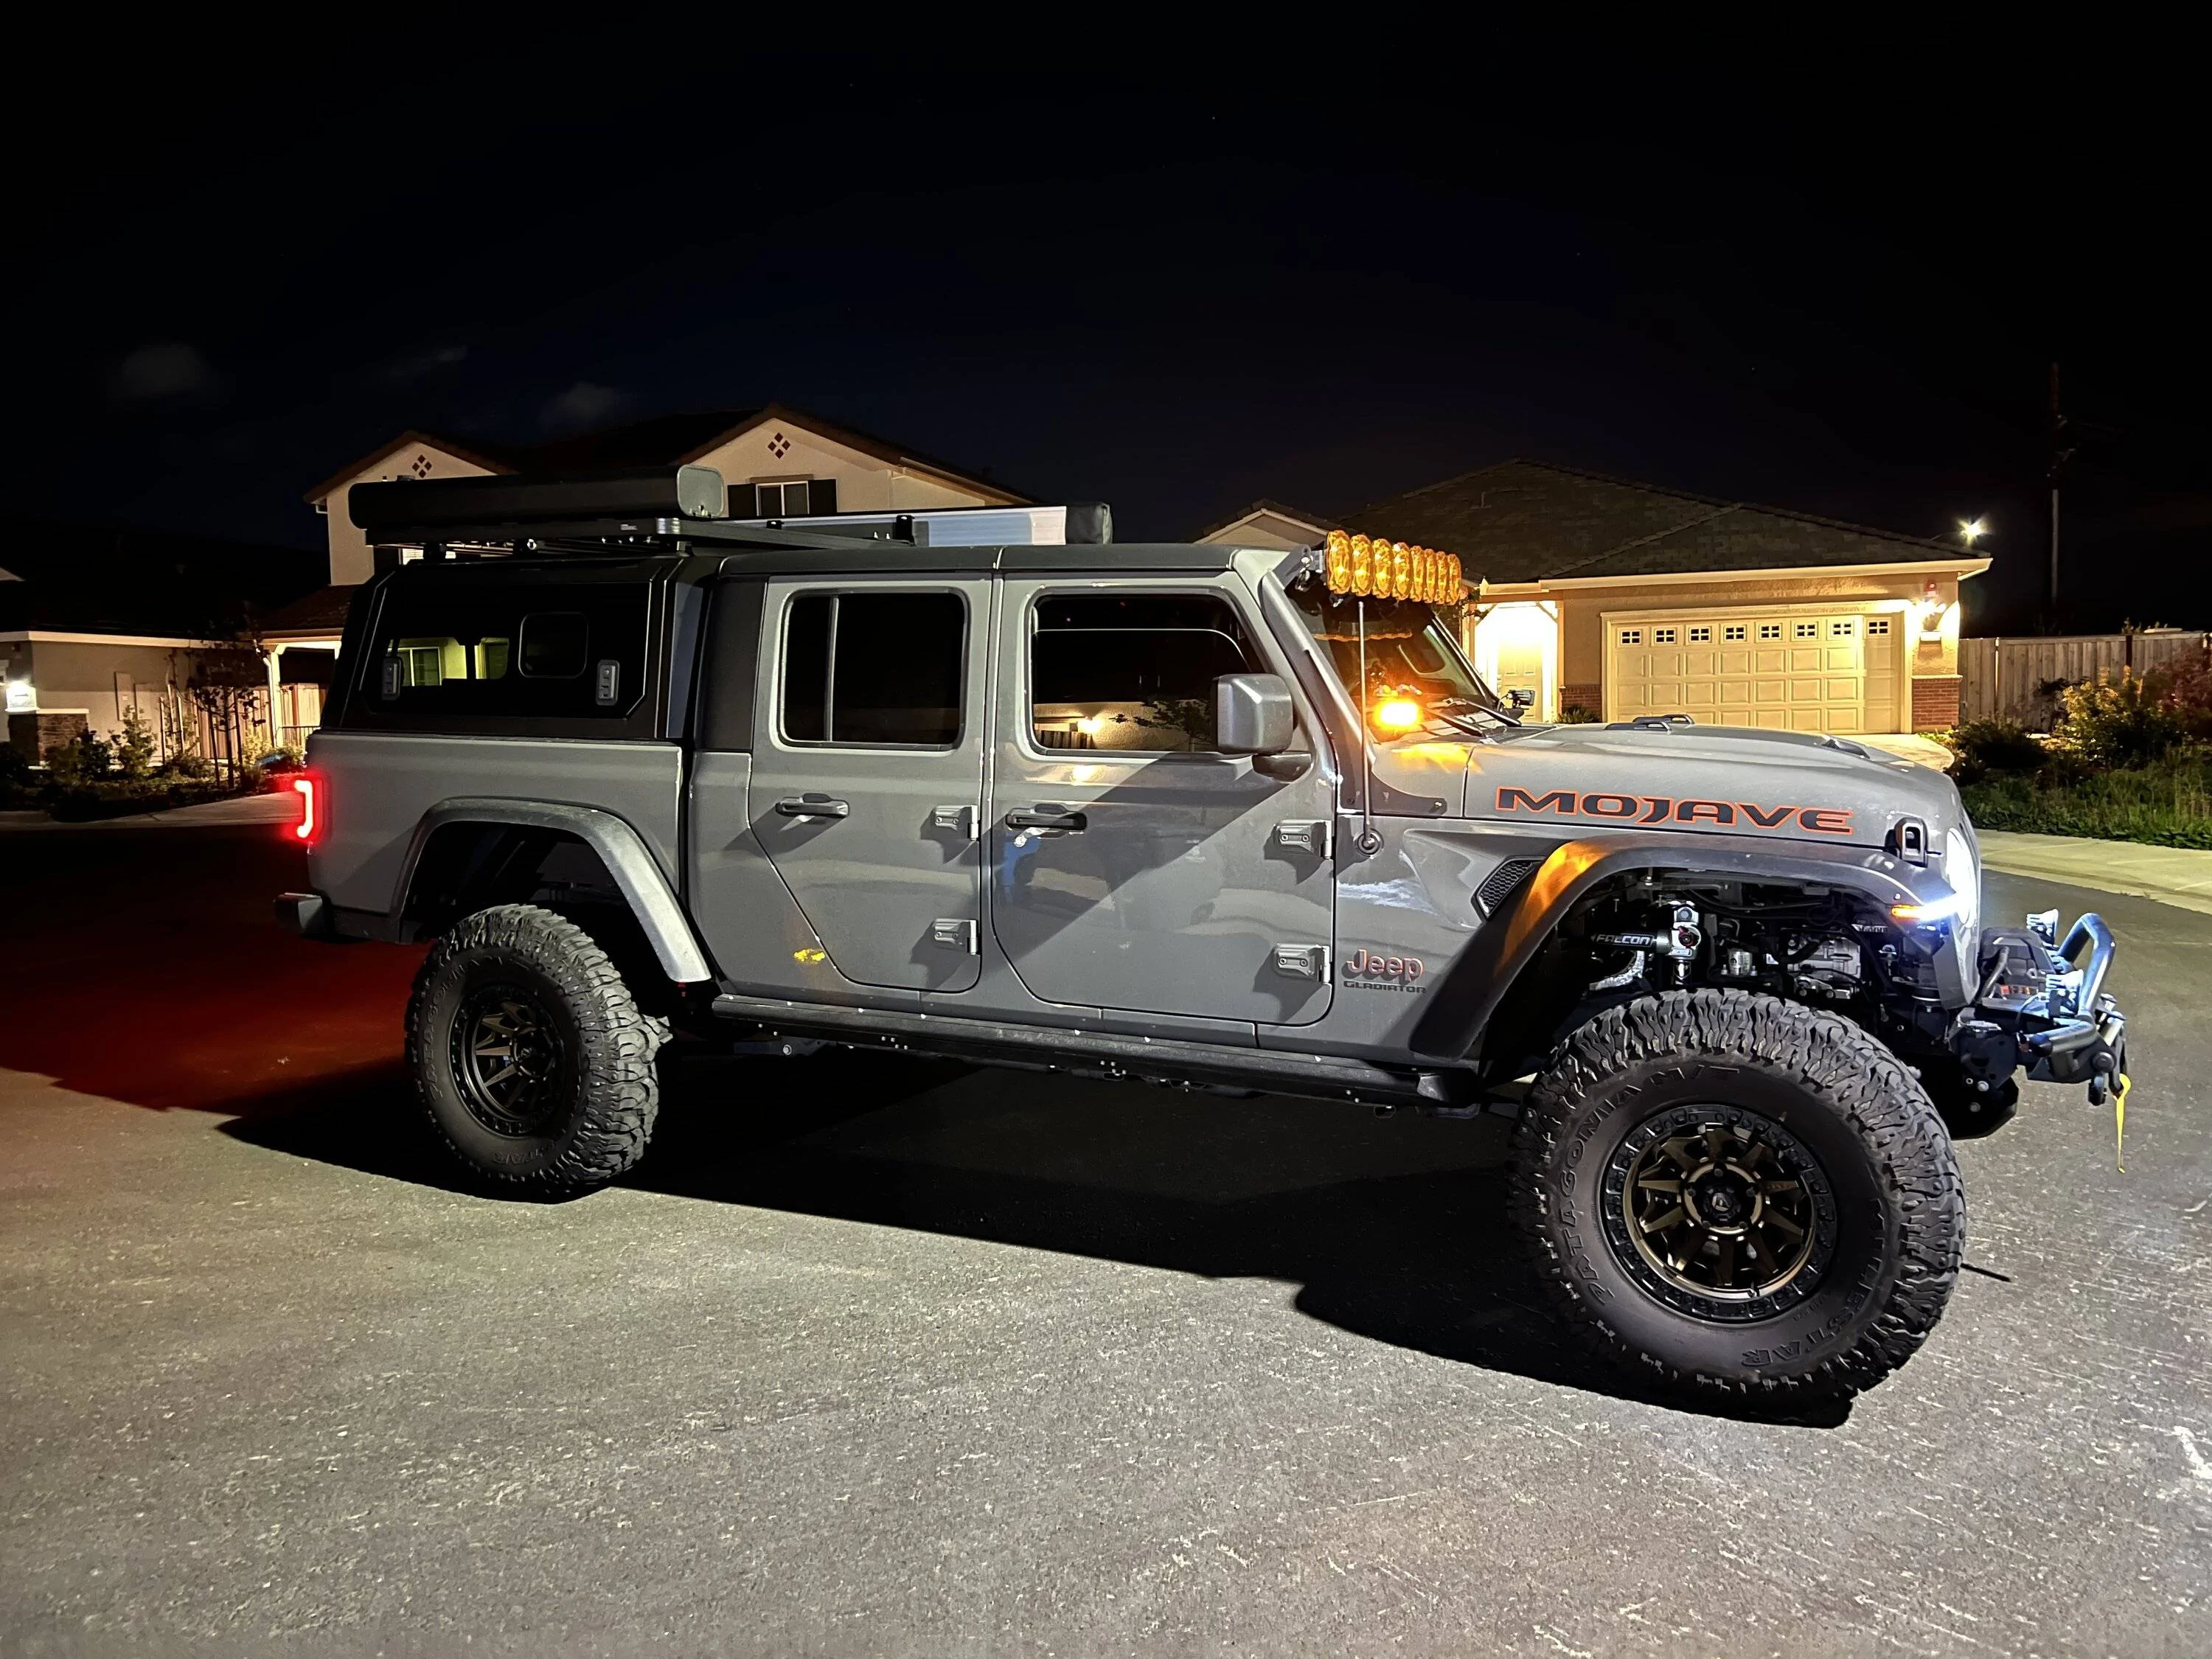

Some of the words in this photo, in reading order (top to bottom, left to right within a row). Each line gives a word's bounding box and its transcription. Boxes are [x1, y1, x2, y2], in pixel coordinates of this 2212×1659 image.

[1495, 786, 1854, 835] MOJAVE
[1596, 933, 1651, 946] FALCON
[1346, 948, 1425, 984] Jeep
[1343, 981, 1427, 993] GLADIATOR
